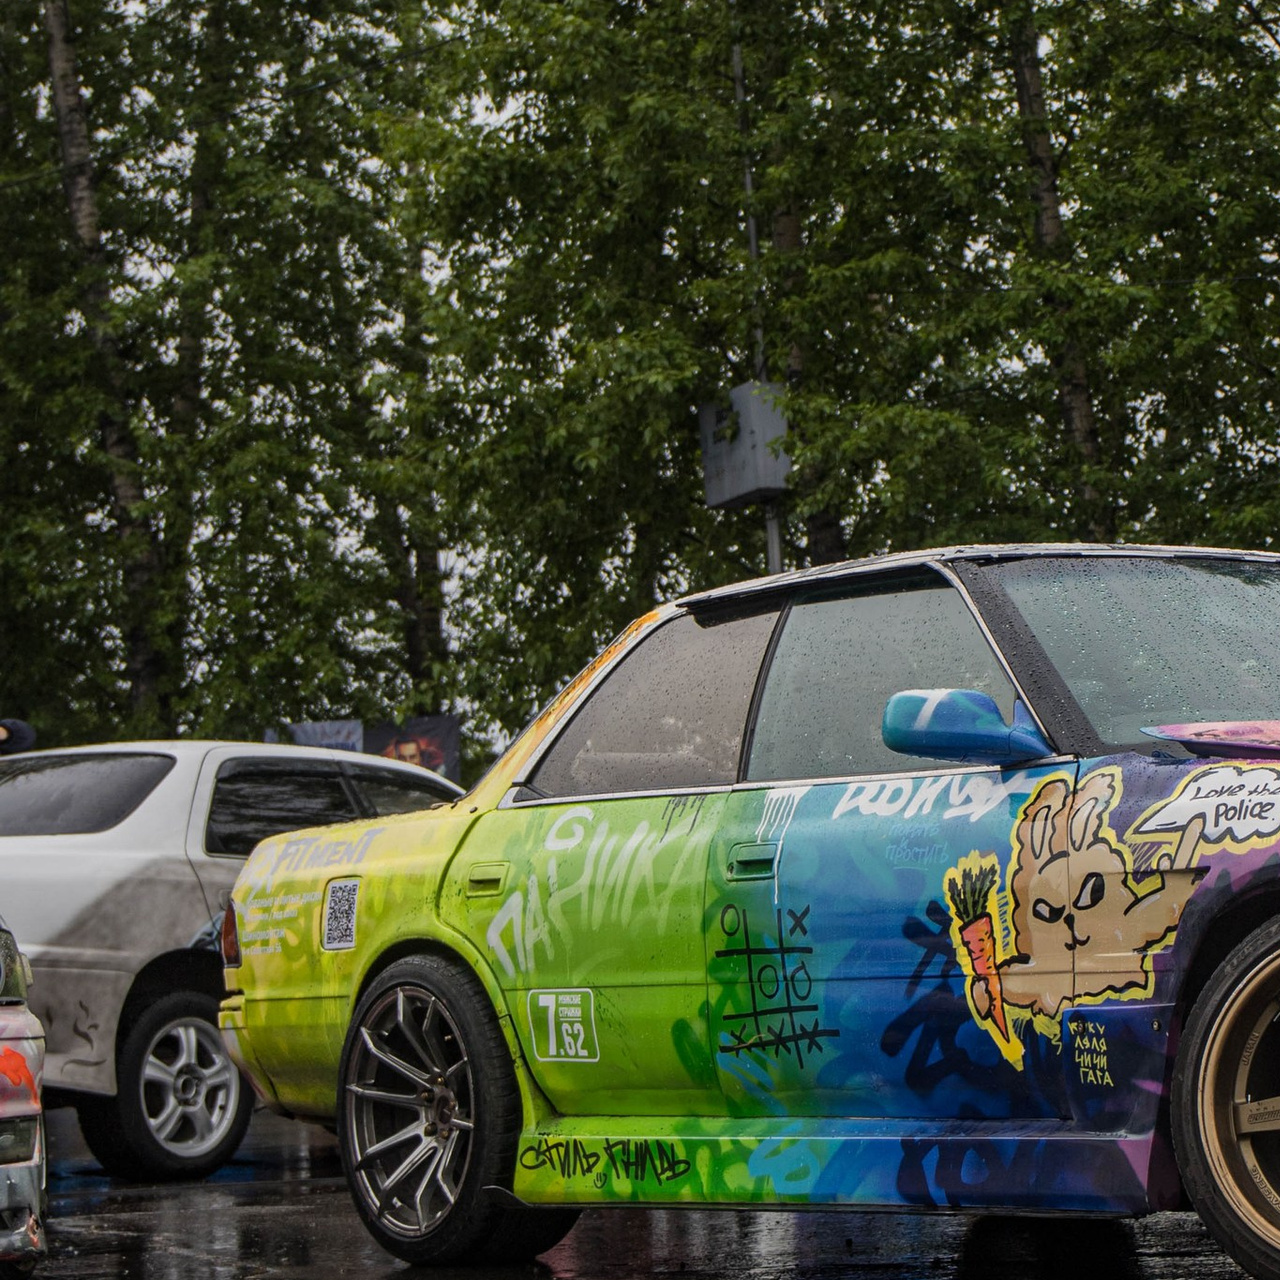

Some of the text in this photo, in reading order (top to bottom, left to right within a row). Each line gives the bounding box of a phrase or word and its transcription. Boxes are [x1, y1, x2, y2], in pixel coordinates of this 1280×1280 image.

[1190, 783, 1246, 801] Love
[1067, 1021, 1106, 1035] ККУ
[1242, 1032, 1260, 1066] JAPAN
